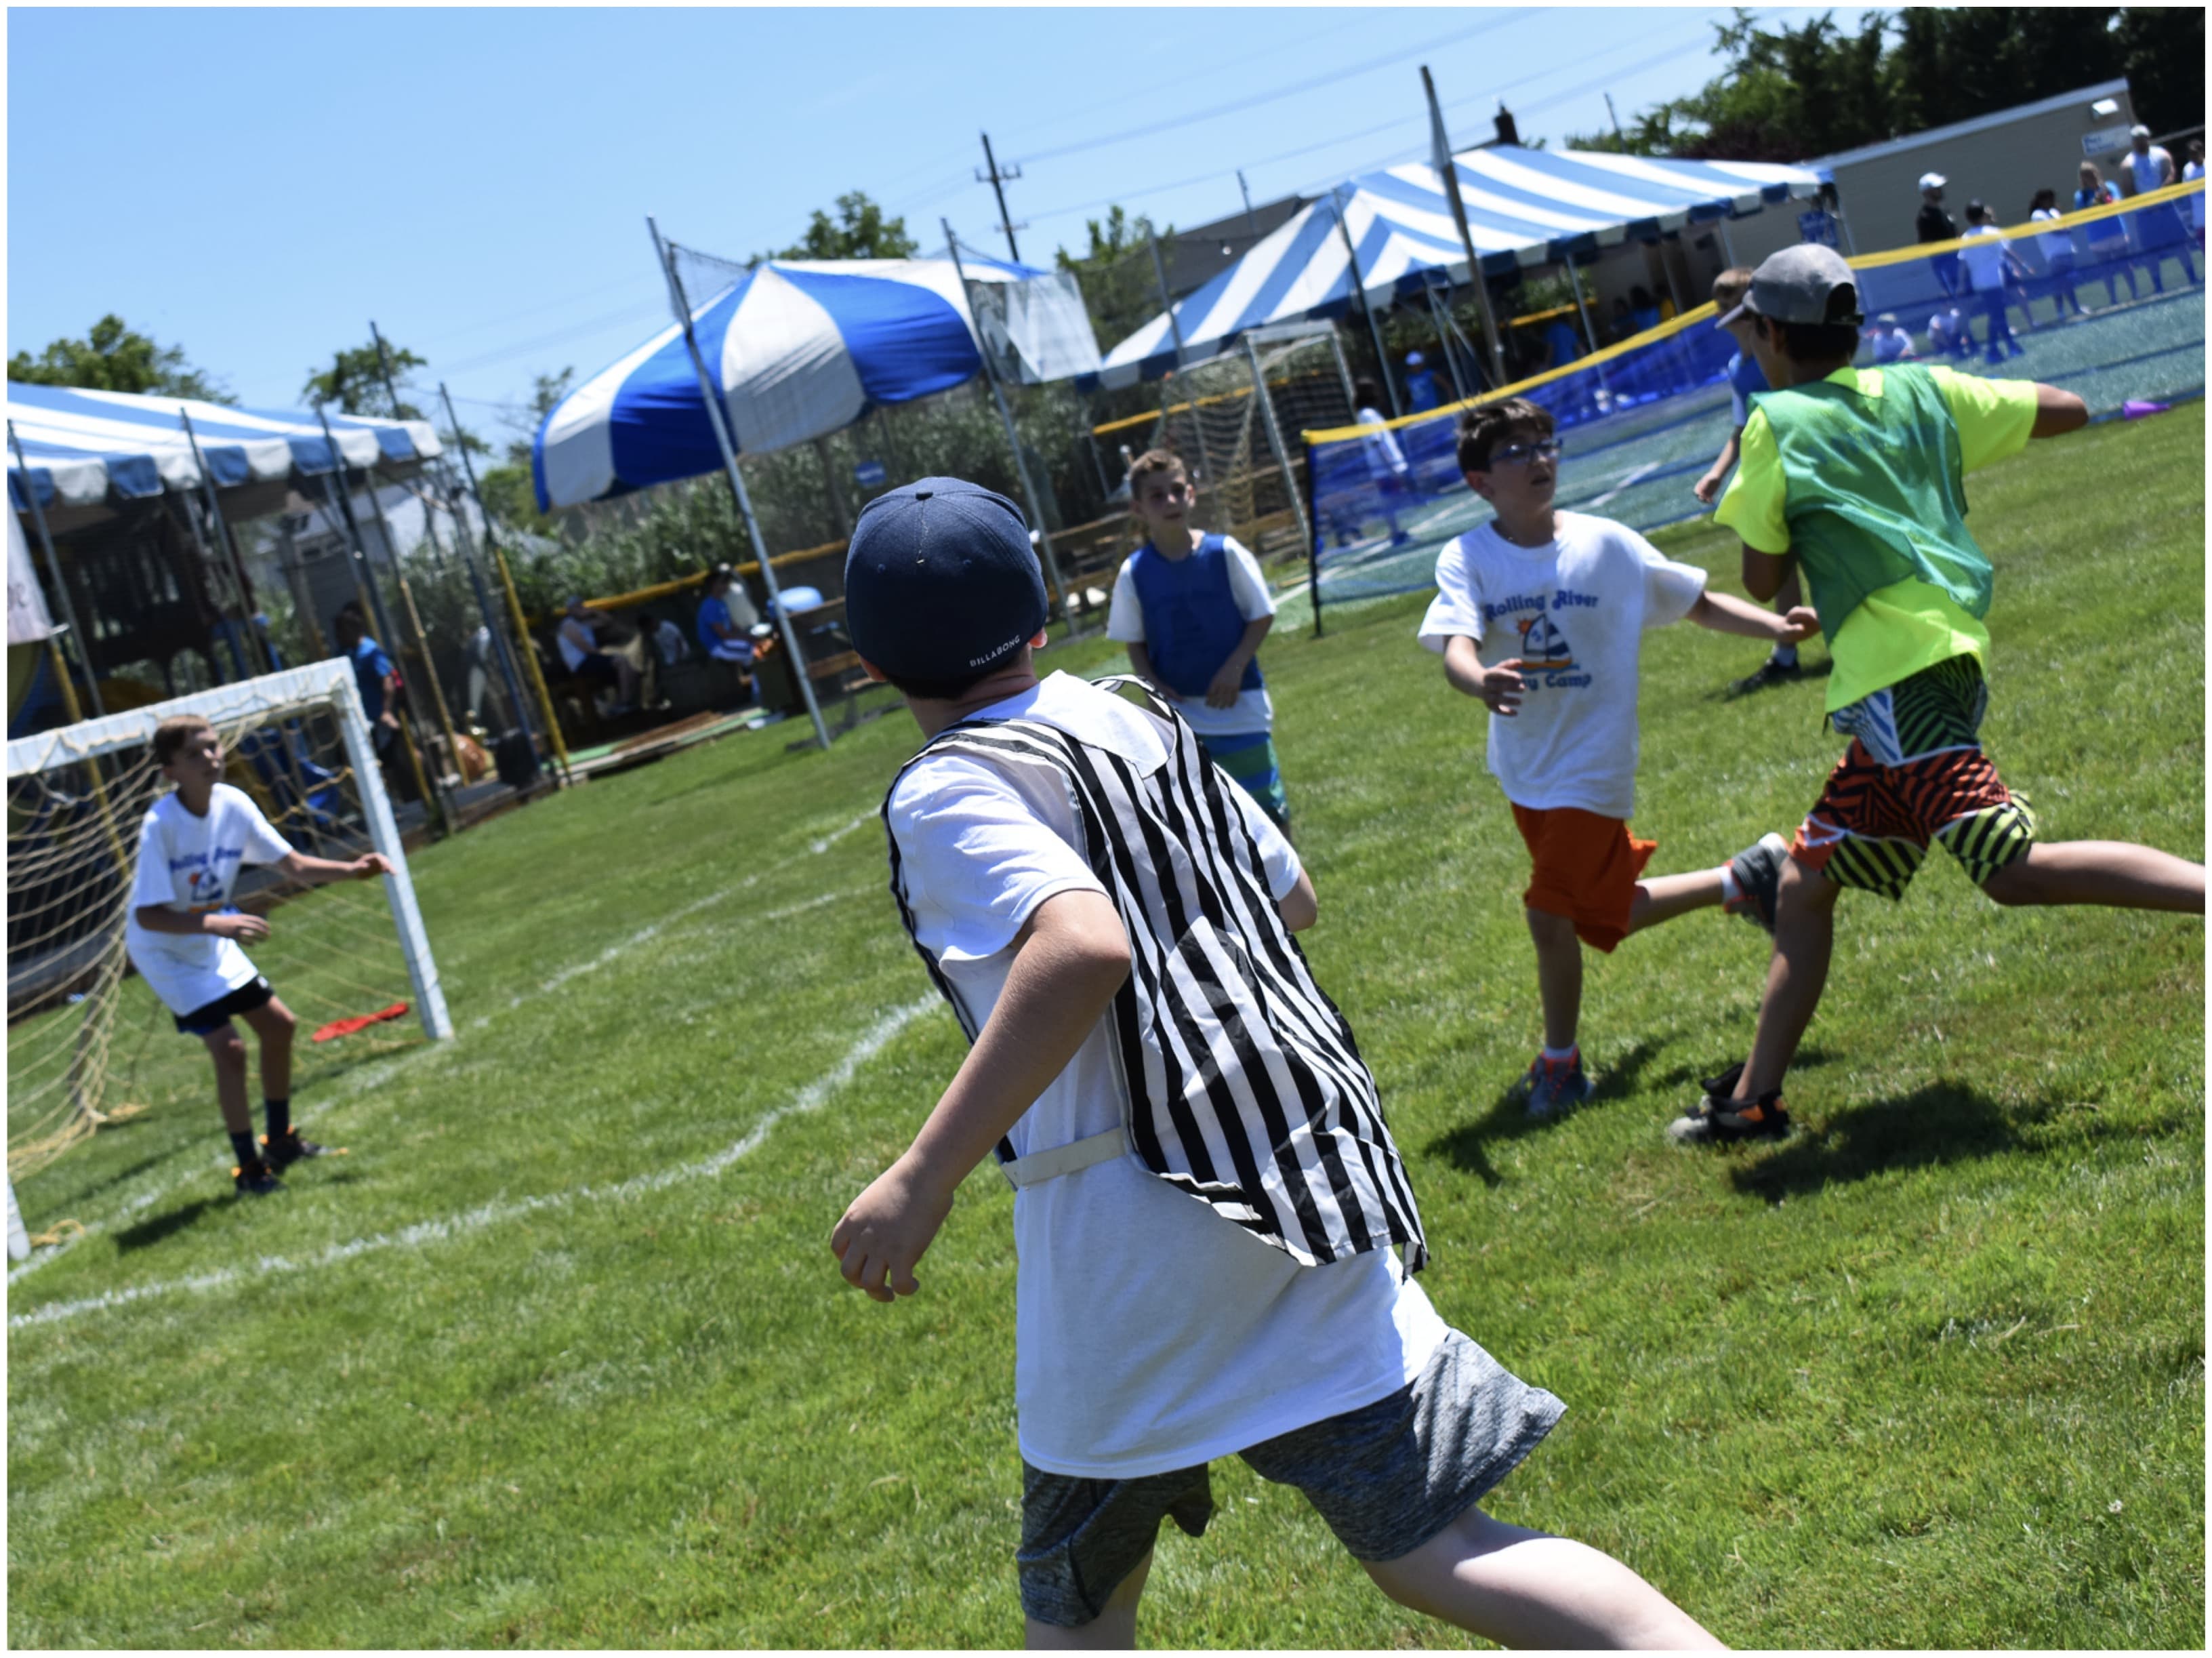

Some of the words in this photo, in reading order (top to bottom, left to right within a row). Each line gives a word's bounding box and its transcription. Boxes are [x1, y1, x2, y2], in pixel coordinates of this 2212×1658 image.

[1484, 595, 1546, 622] Rolling
[1552, 590, 1599, 609] River
[969, 634, 1020, 667] BILLABONG
[1545, 672, 1592, 689] Camp
